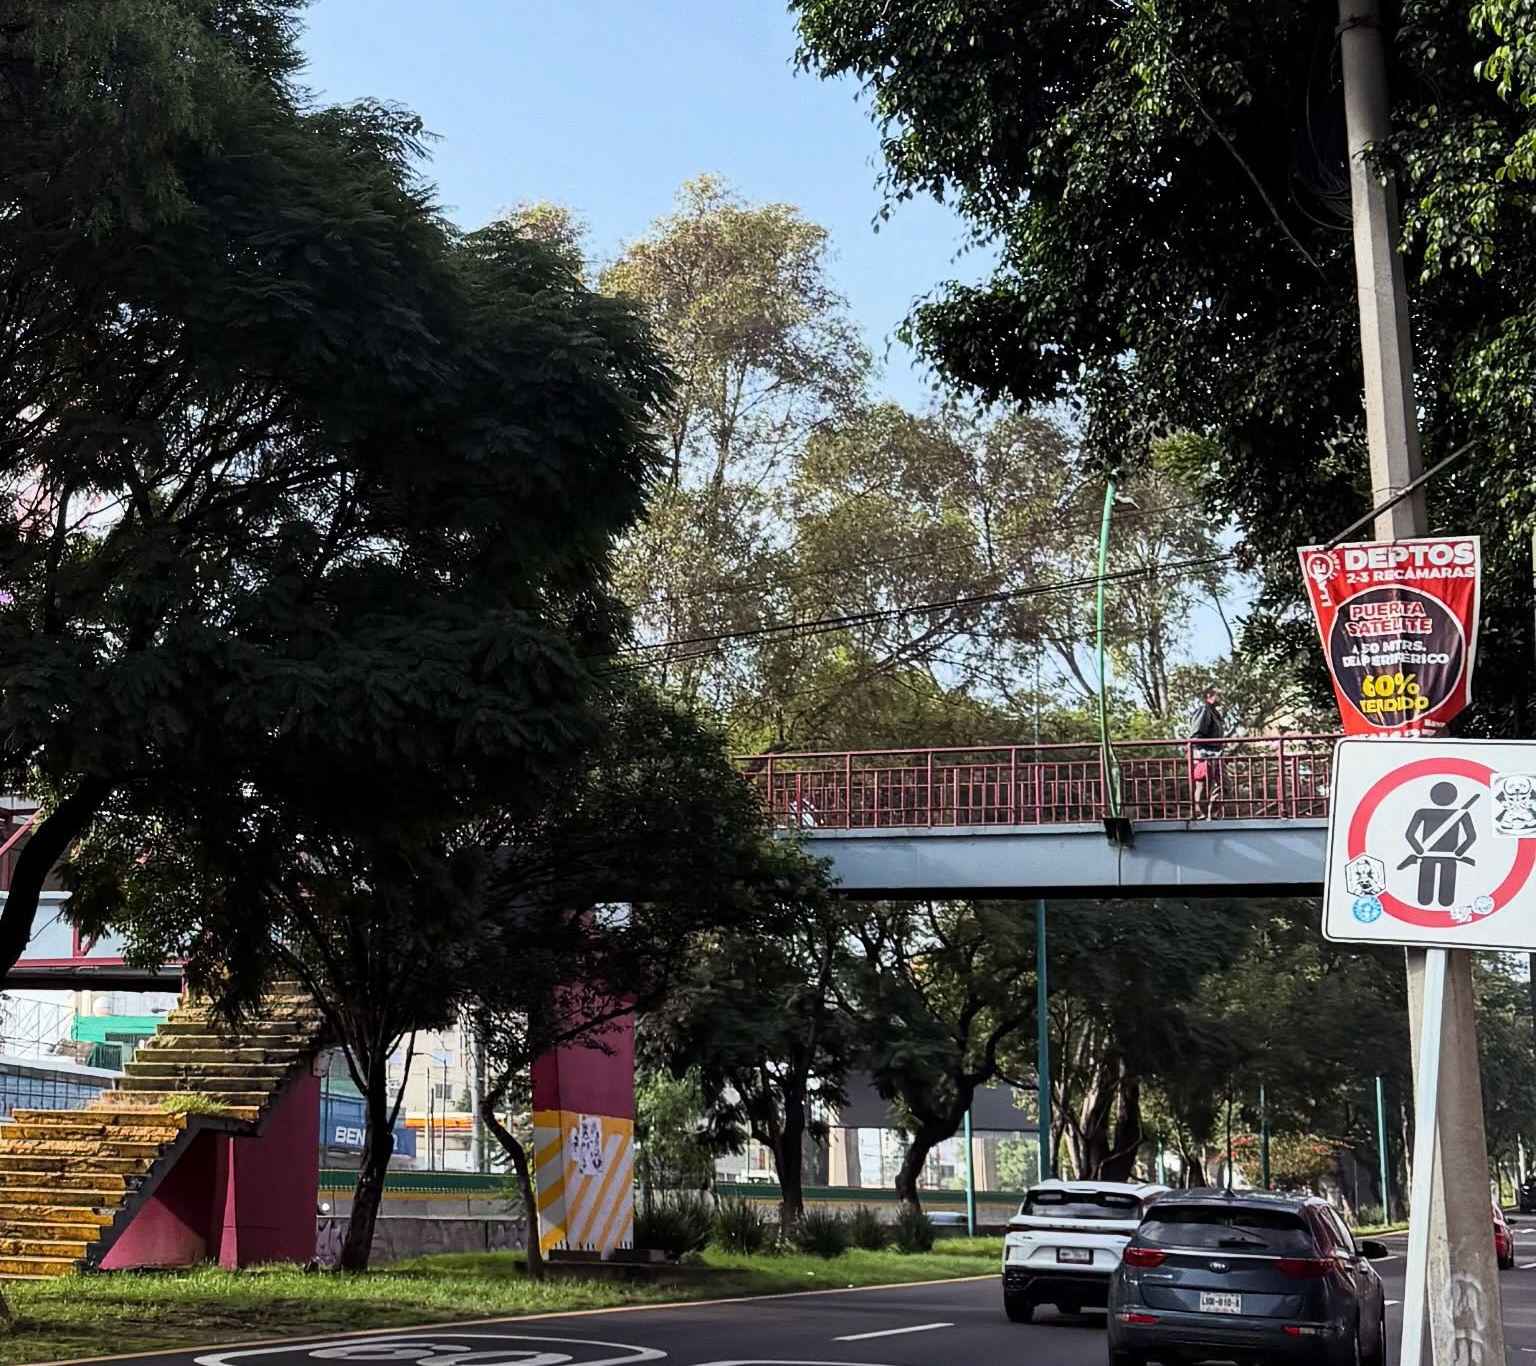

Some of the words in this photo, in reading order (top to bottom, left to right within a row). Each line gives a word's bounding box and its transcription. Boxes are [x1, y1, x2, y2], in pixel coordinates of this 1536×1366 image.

[1344, 542, 1475, 571] DEPTOS
[1346, 571, 1370, 584] 2-3
[1351, 601, 1426, 621] PUERTA
[1383, 640, 1427, 652] MTRS.
[1362, 673, 1421, 697] 60%
